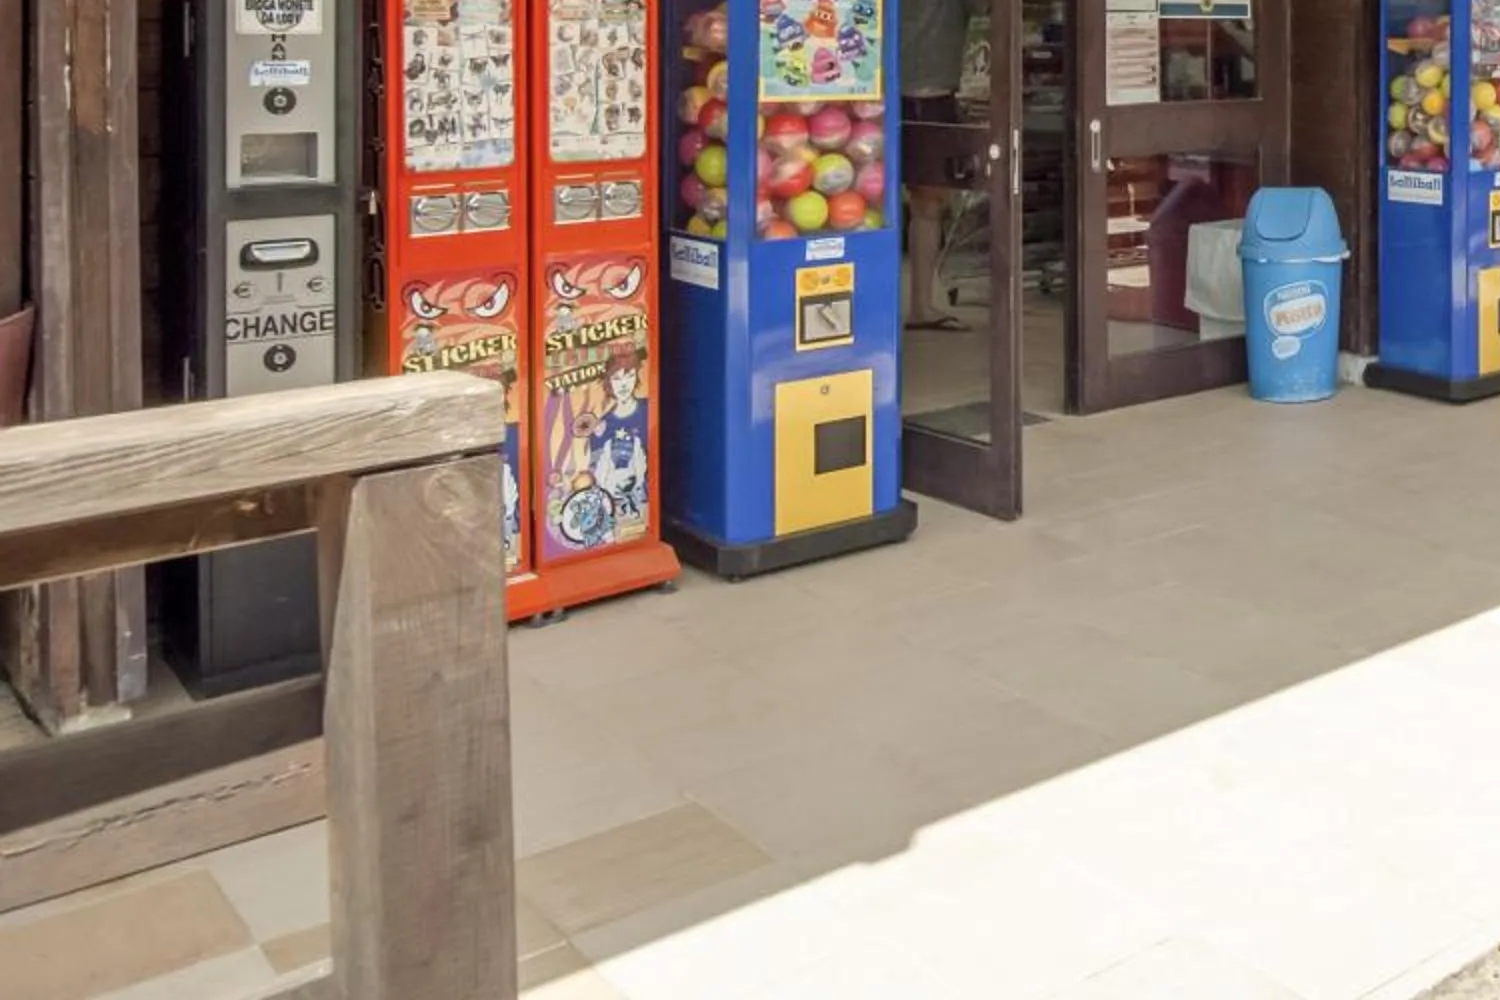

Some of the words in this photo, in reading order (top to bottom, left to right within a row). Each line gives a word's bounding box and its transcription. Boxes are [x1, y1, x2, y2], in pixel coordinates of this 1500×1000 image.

[225, 310, 336, 340] CHANGE
[545, 313, 648, 353] STICKER
[404, 335, 516, 373] STICKER
